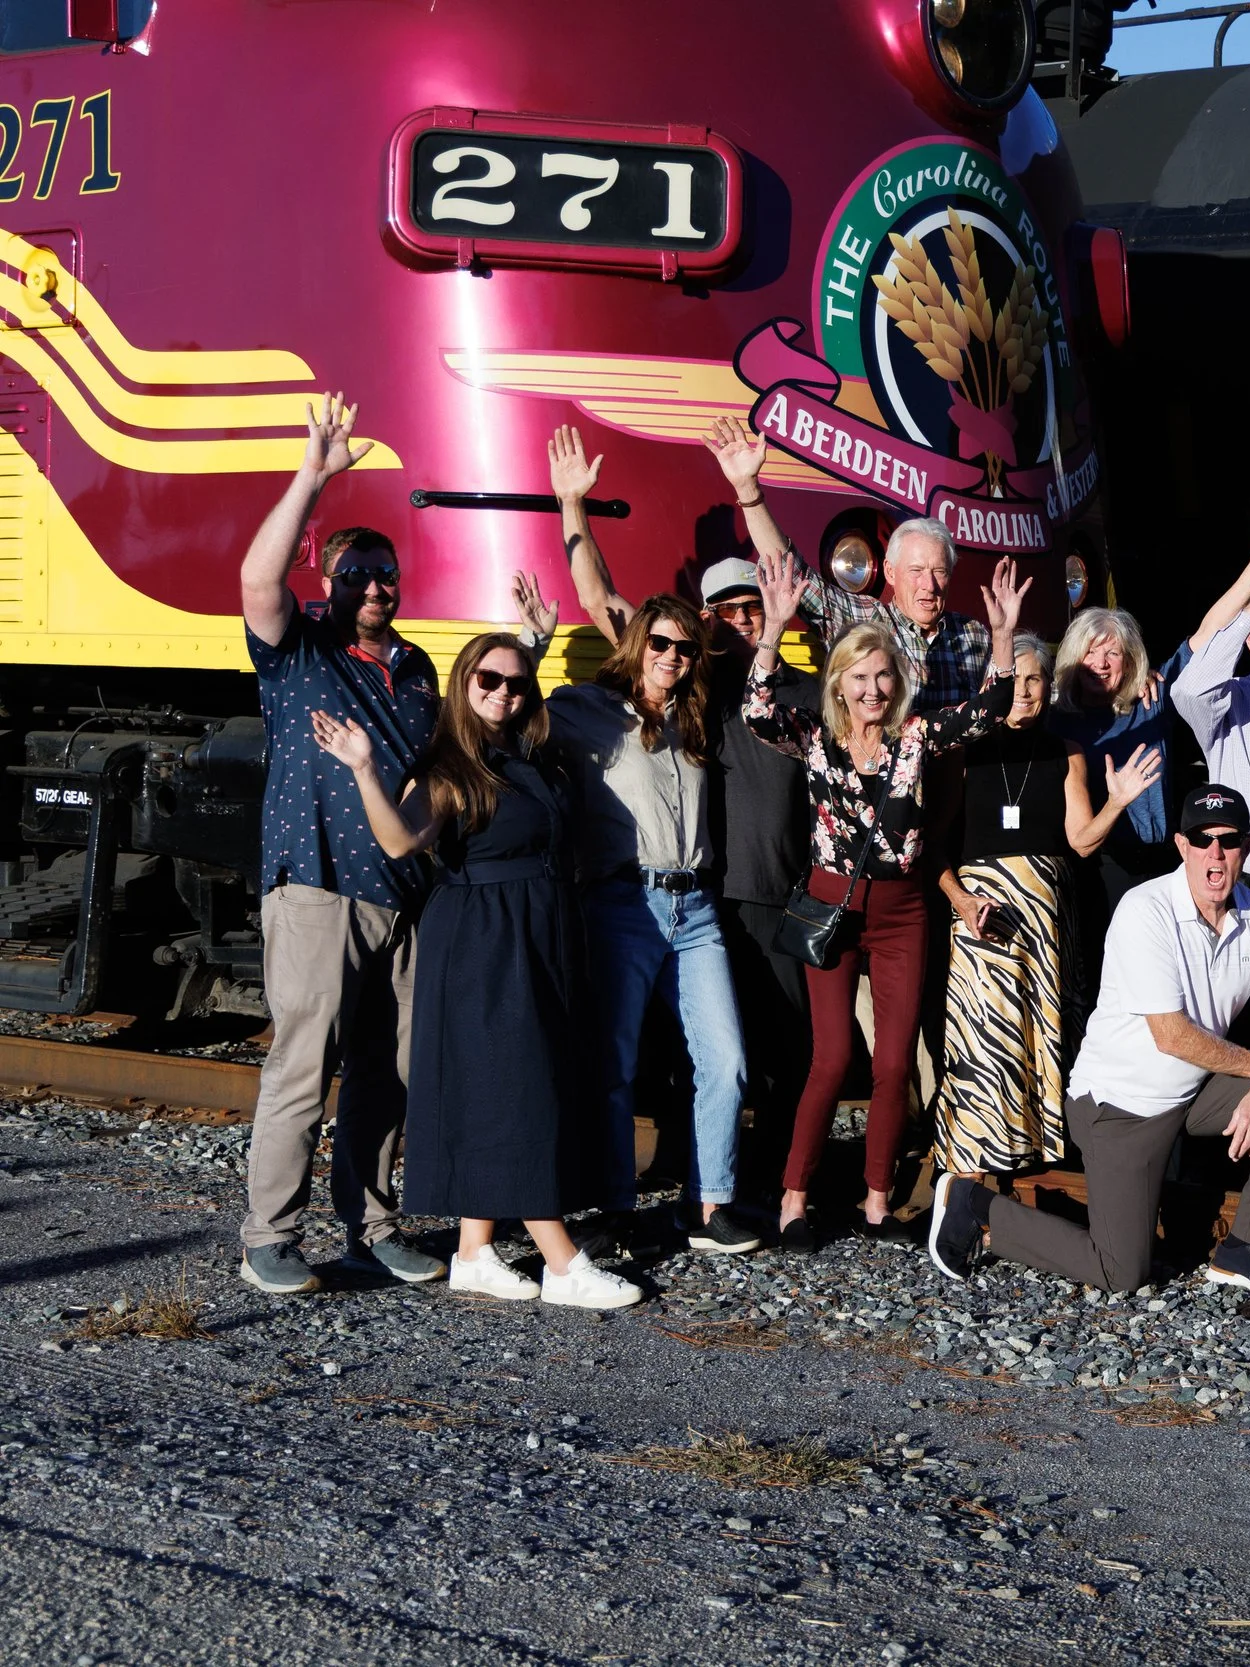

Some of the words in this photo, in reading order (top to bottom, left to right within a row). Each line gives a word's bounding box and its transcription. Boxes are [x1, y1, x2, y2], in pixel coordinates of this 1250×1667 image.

[0, 88, 121, 203] 271
[431, 146, 706, 239] 271
[825, 224, 872, 327] THE
[873, 151, 1008, 219] Carolina
[1018, 210, 1071, 368] ROUTE
[763, 393, 928, 505] ABERDEEN
[938, 500, 1046, 548] CAROLINA
[1046, 482, 1059, 520] &
